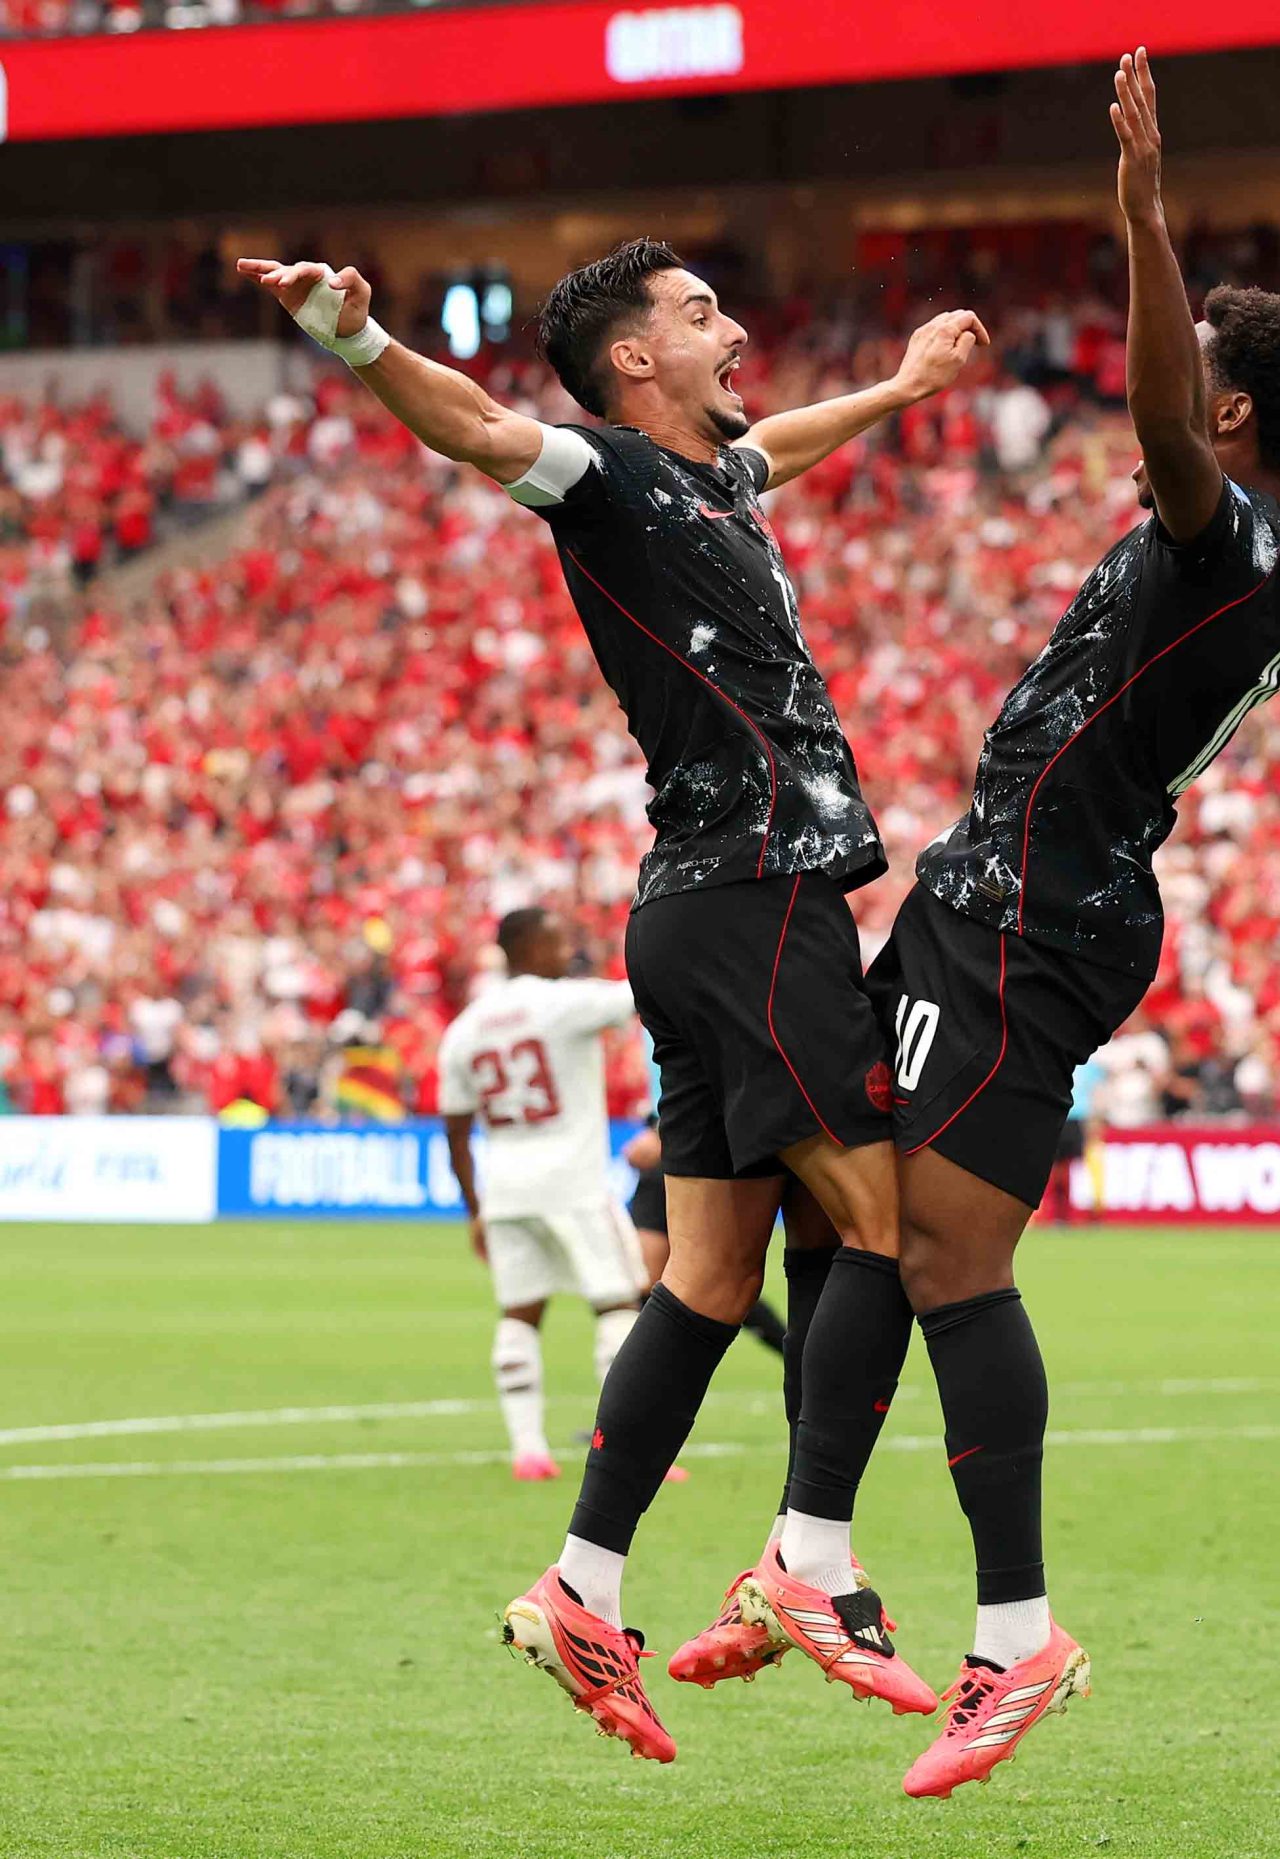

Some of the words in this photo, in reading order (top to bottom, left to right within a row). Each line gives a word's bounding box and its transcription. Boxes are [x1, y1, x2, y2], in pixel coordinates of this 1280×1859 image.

[676, 856, 721, 870] AERO-FIT
[471, 1038, 561, 1127] 23
[894, 993, 941, 1092] 10
